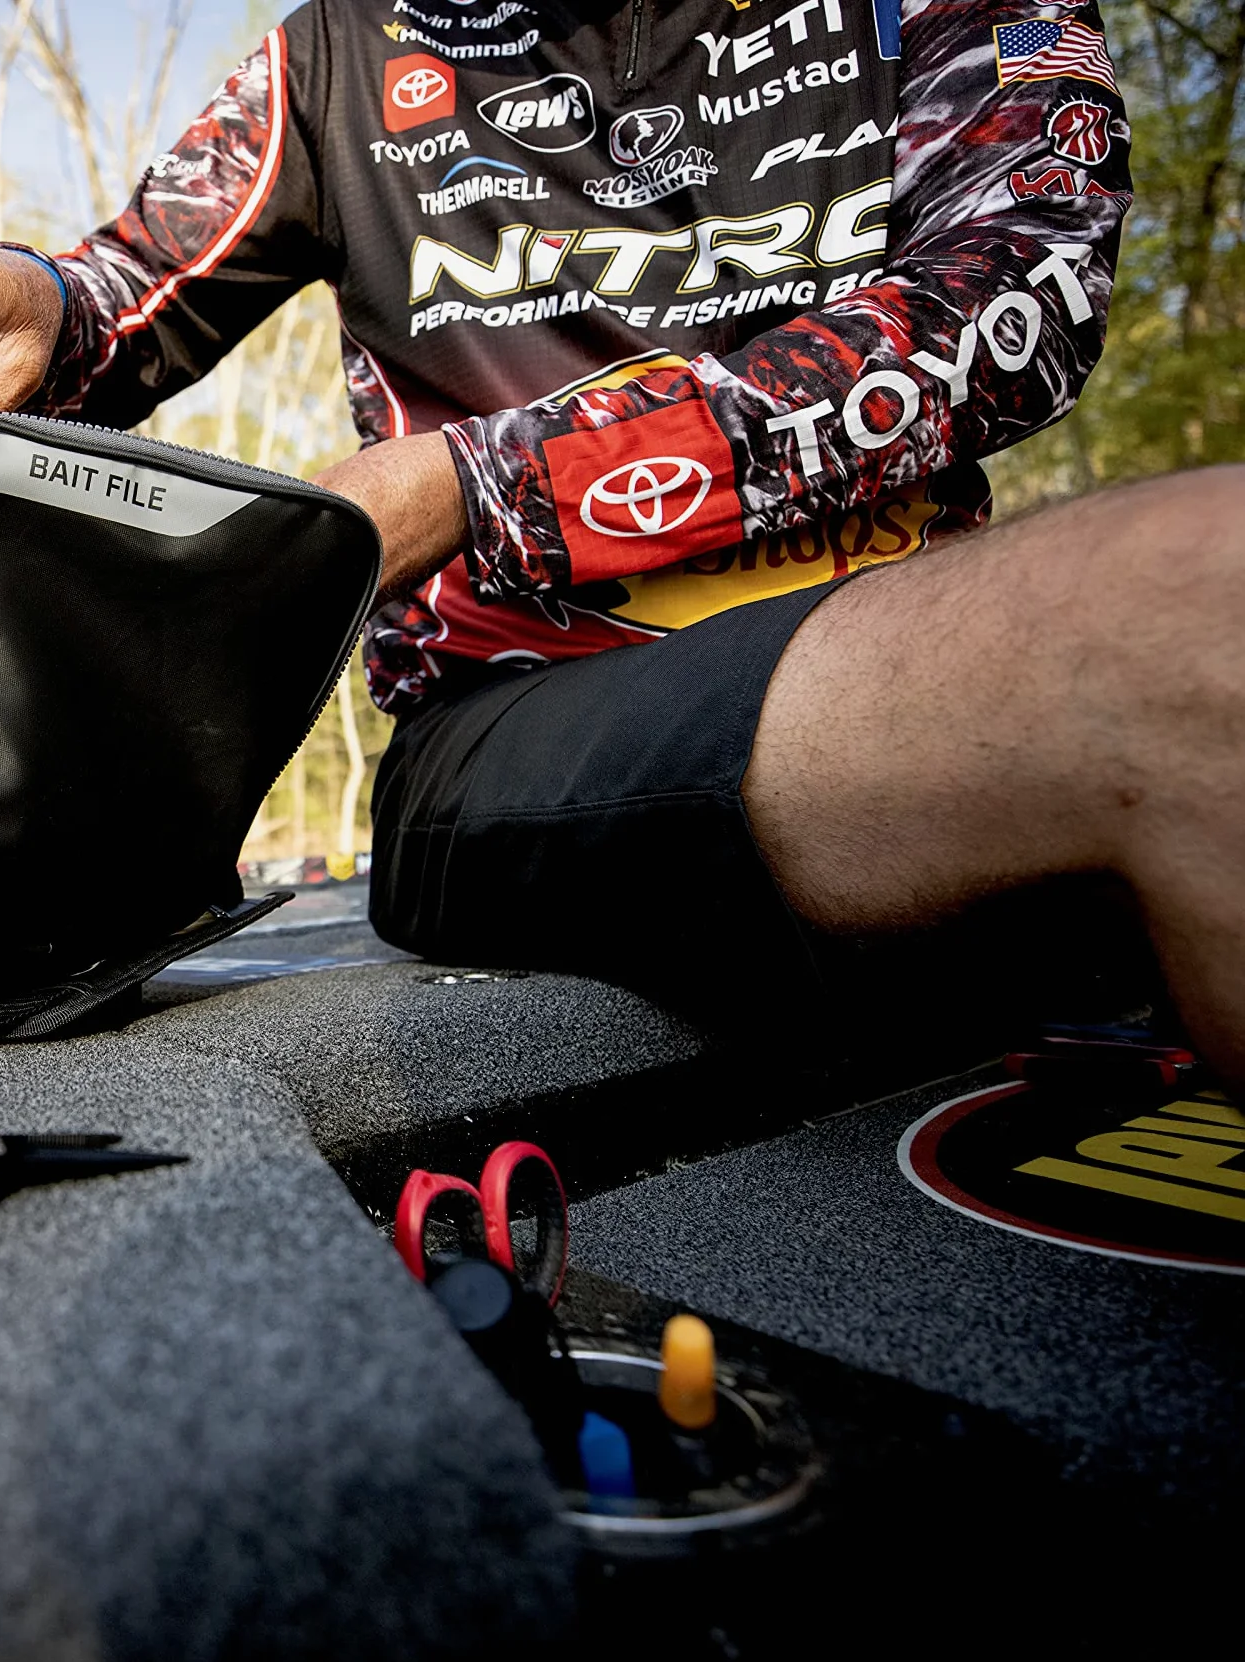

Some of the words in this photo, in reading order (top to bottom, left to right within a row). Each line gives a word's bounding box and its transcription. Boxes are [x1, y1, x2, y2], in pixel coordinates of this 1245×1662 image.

[393, 0, 452, 29] Kevin
[461, 2, 538, 29] VanDa
[695, 0, 843, 77] YETI
[698, 49, 860, 124] Mustad
[369, 130, 470, 167] TOYOTA
[417, 175, 550, 215] THERMACELL
[583, 158, 667, 196] MOSSY
[659, 281, 816, 328] FISHING
[29, 453, 100, 497] BAIT
[105, 475, 167, 512] FILE
